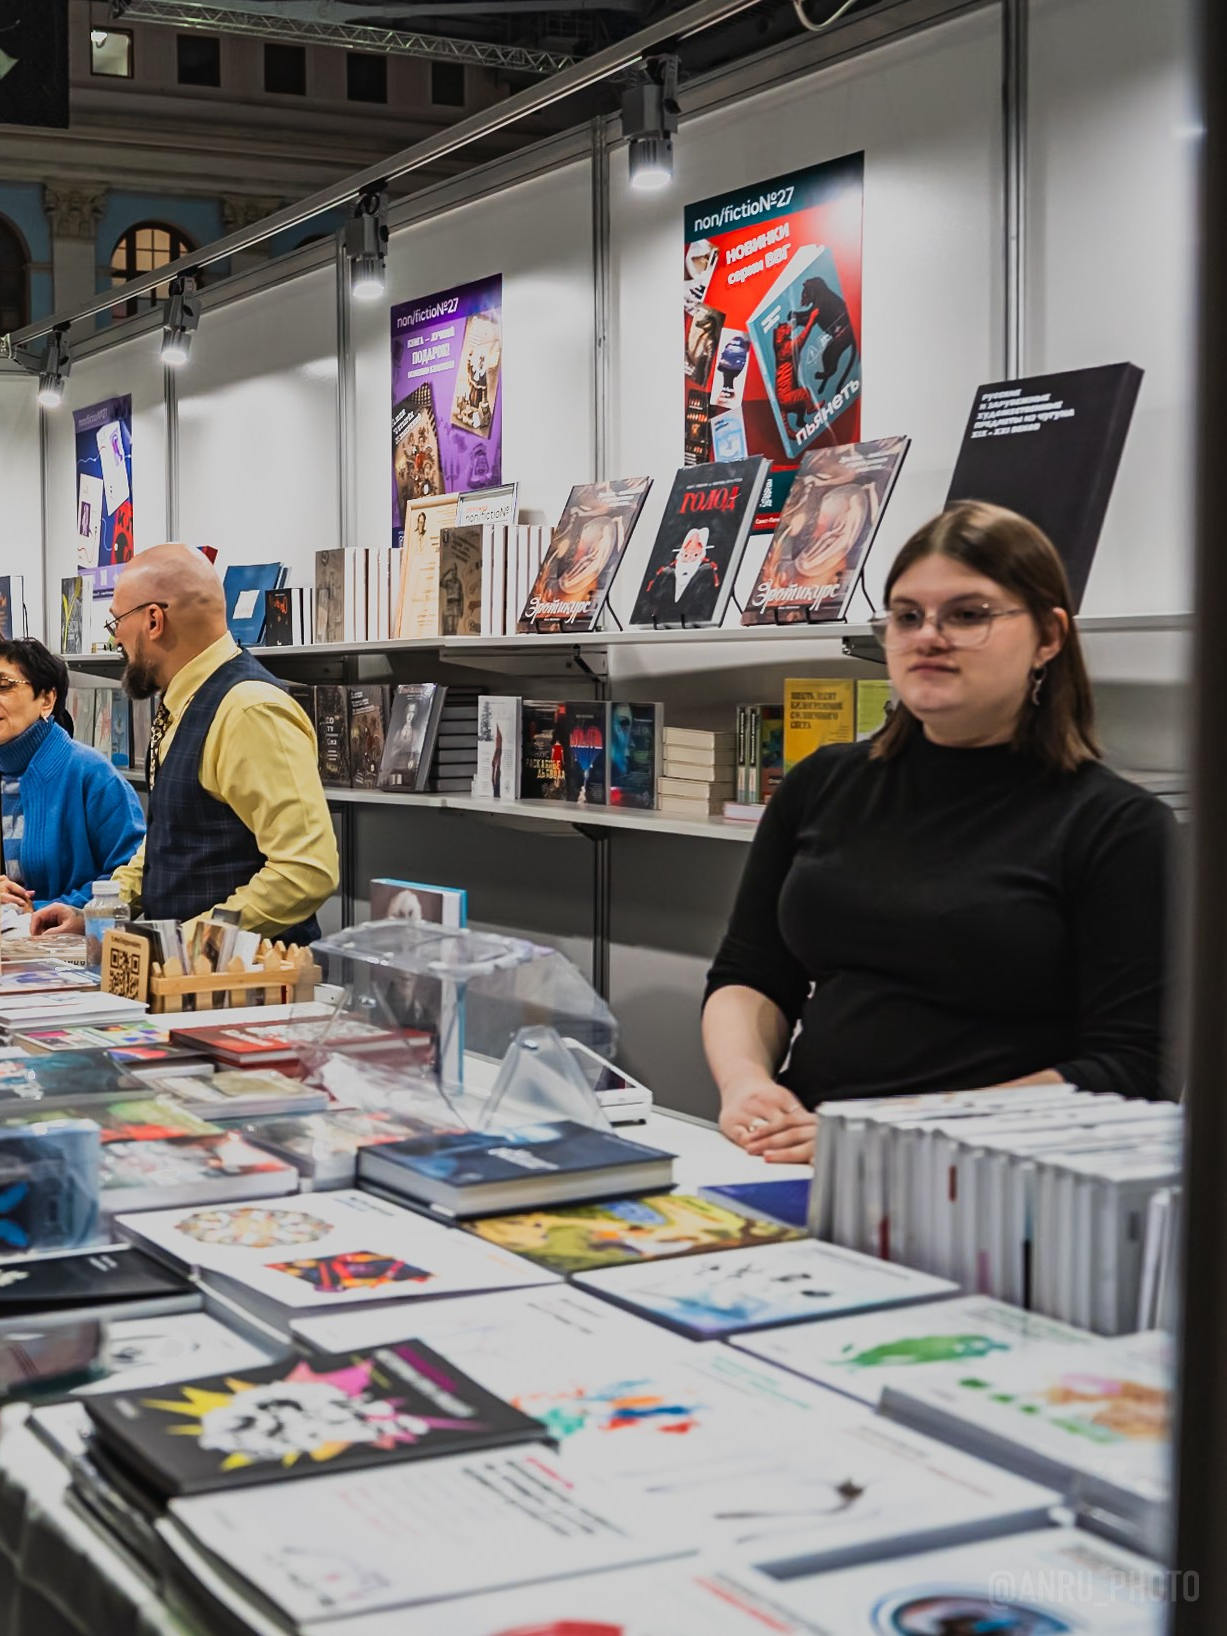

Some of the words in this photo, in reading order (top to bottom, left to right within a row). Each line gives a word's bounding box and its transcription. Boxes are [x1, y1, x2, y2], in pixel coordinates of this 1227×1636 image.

[725, 222, 790, 265] НОВИНКИ
[727, 259, 764, 285] серии
[679, 485, 741, 514] ГОЛОД
[524, 594, 592, 625] Эротикурс
[752, 578, 841, 615] Эротикурс
